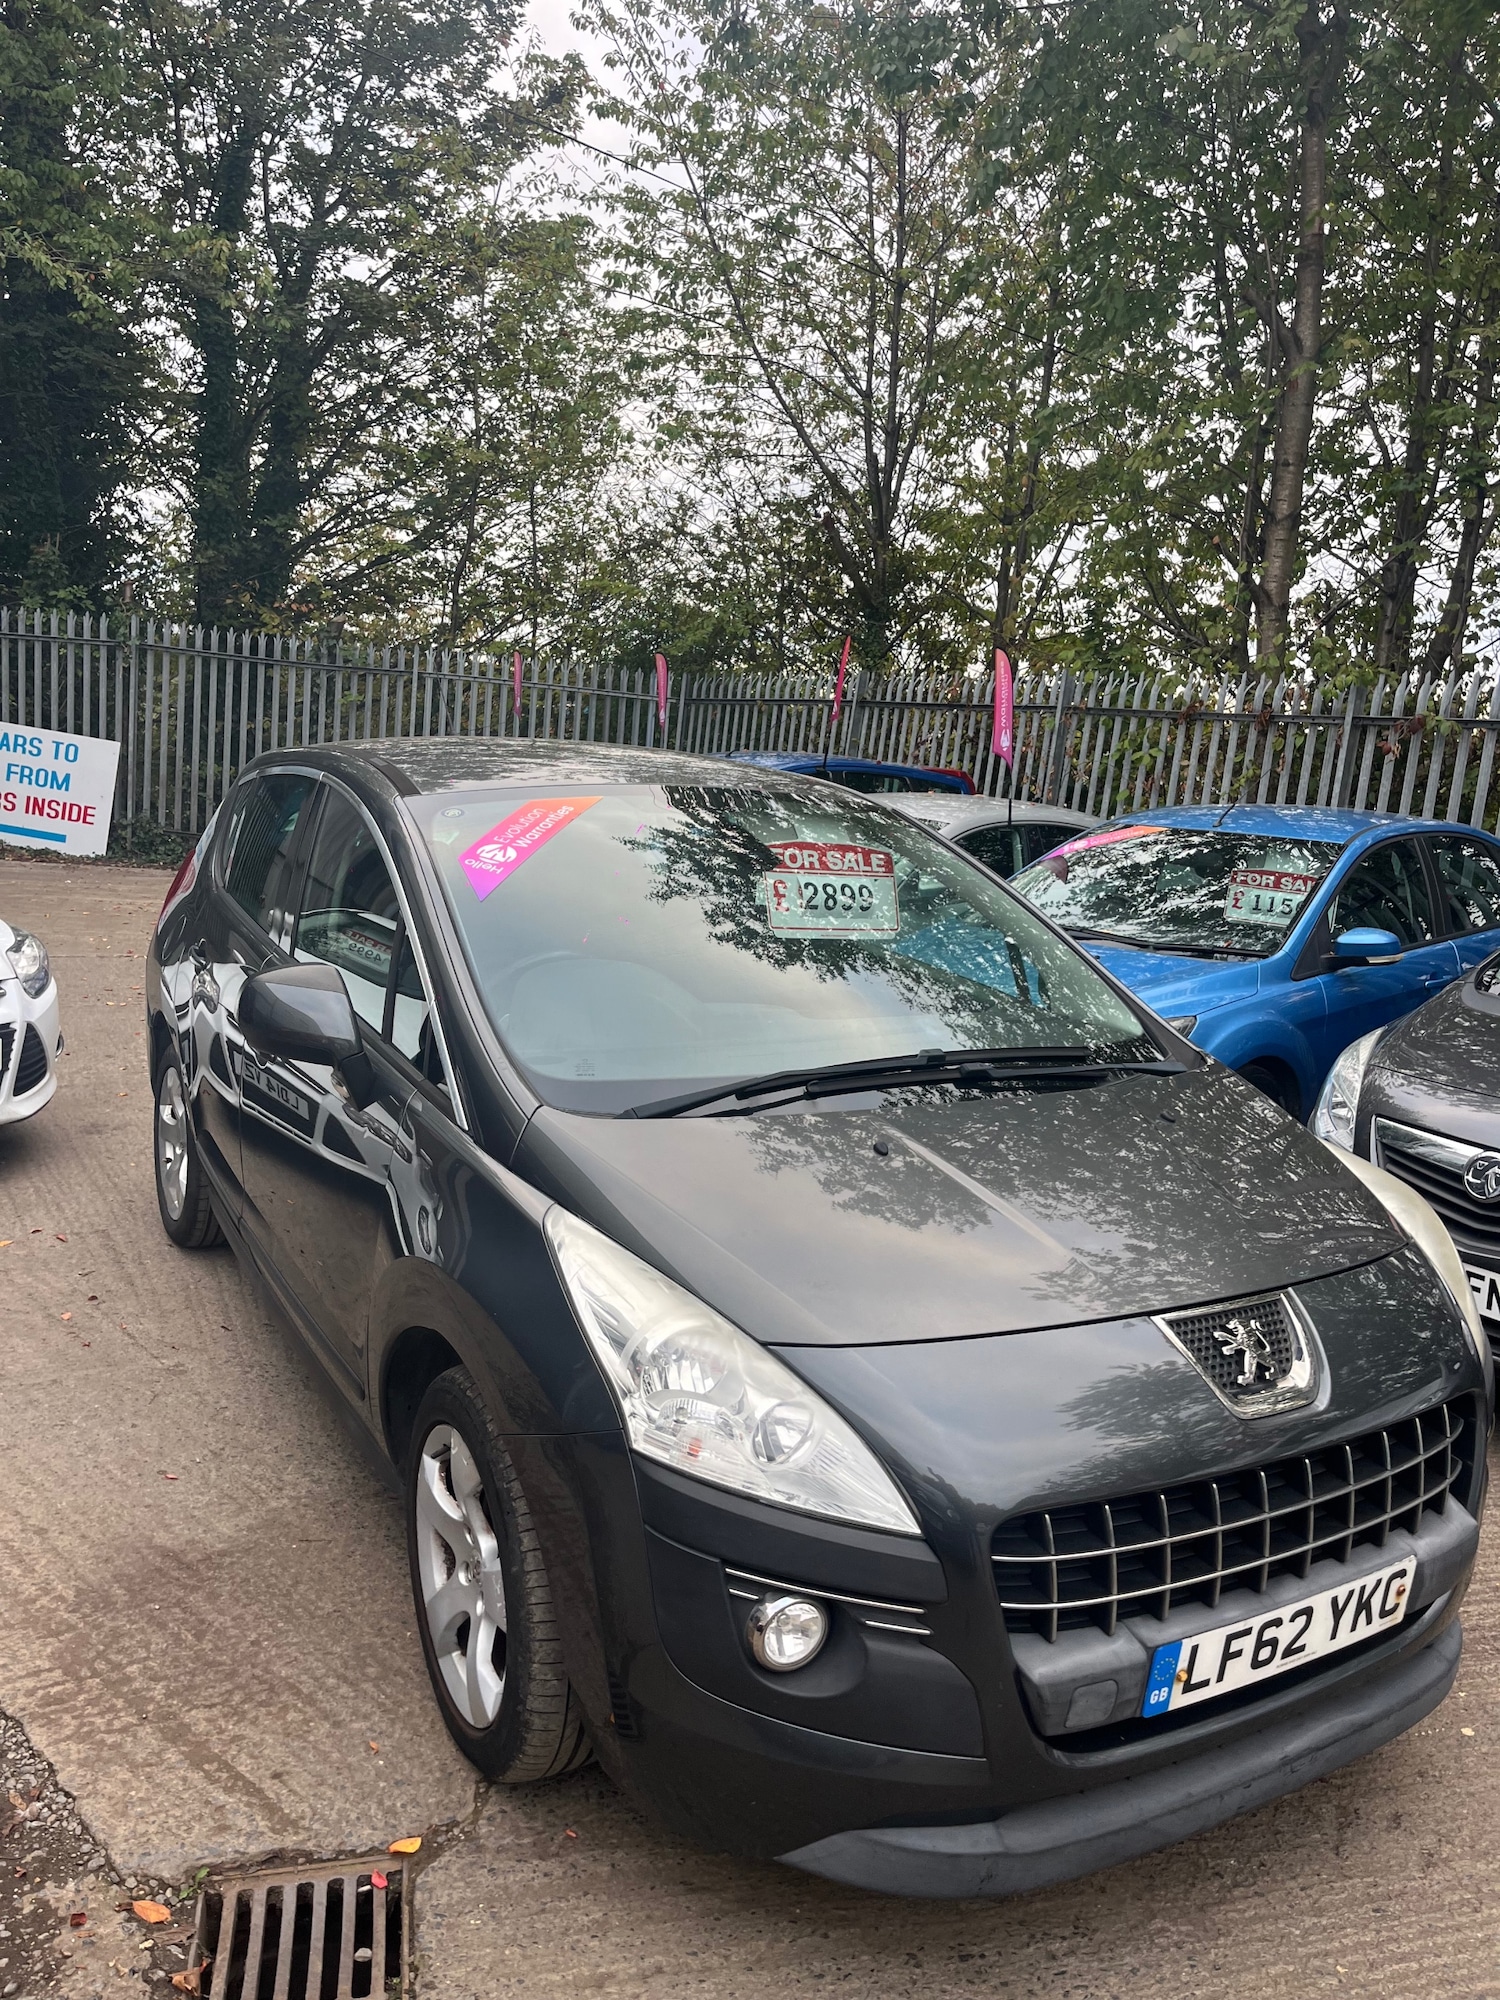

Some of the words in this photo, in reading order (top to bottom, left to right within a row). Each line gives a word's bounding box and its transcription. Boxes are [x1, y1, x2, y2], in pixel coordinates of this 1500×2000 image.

[0, 732, 43, 757] ARS
[52, 740, 79, 763] TO
[5, 763, 71, 792] FROM
[0, 792, 17, 812] S
[25, 795, 96, 825] INSIDE
[494, 807, 547, 843] Evolution
[512, 804, 574, 848] Warranties
[464, 858, 504, 874] Hello
[826, 851, 886, 872] SALE
[1236, 872, 1274, 887] FOR
[1280, 876, 1315, 892] SAL
[1252, 894, 1301, 915] 115
[1466, 1270, 1500, 1311] FN
[1181, 1605, 1314, 1695] LF62
[1149, 1687, 1169, 1705] GB
